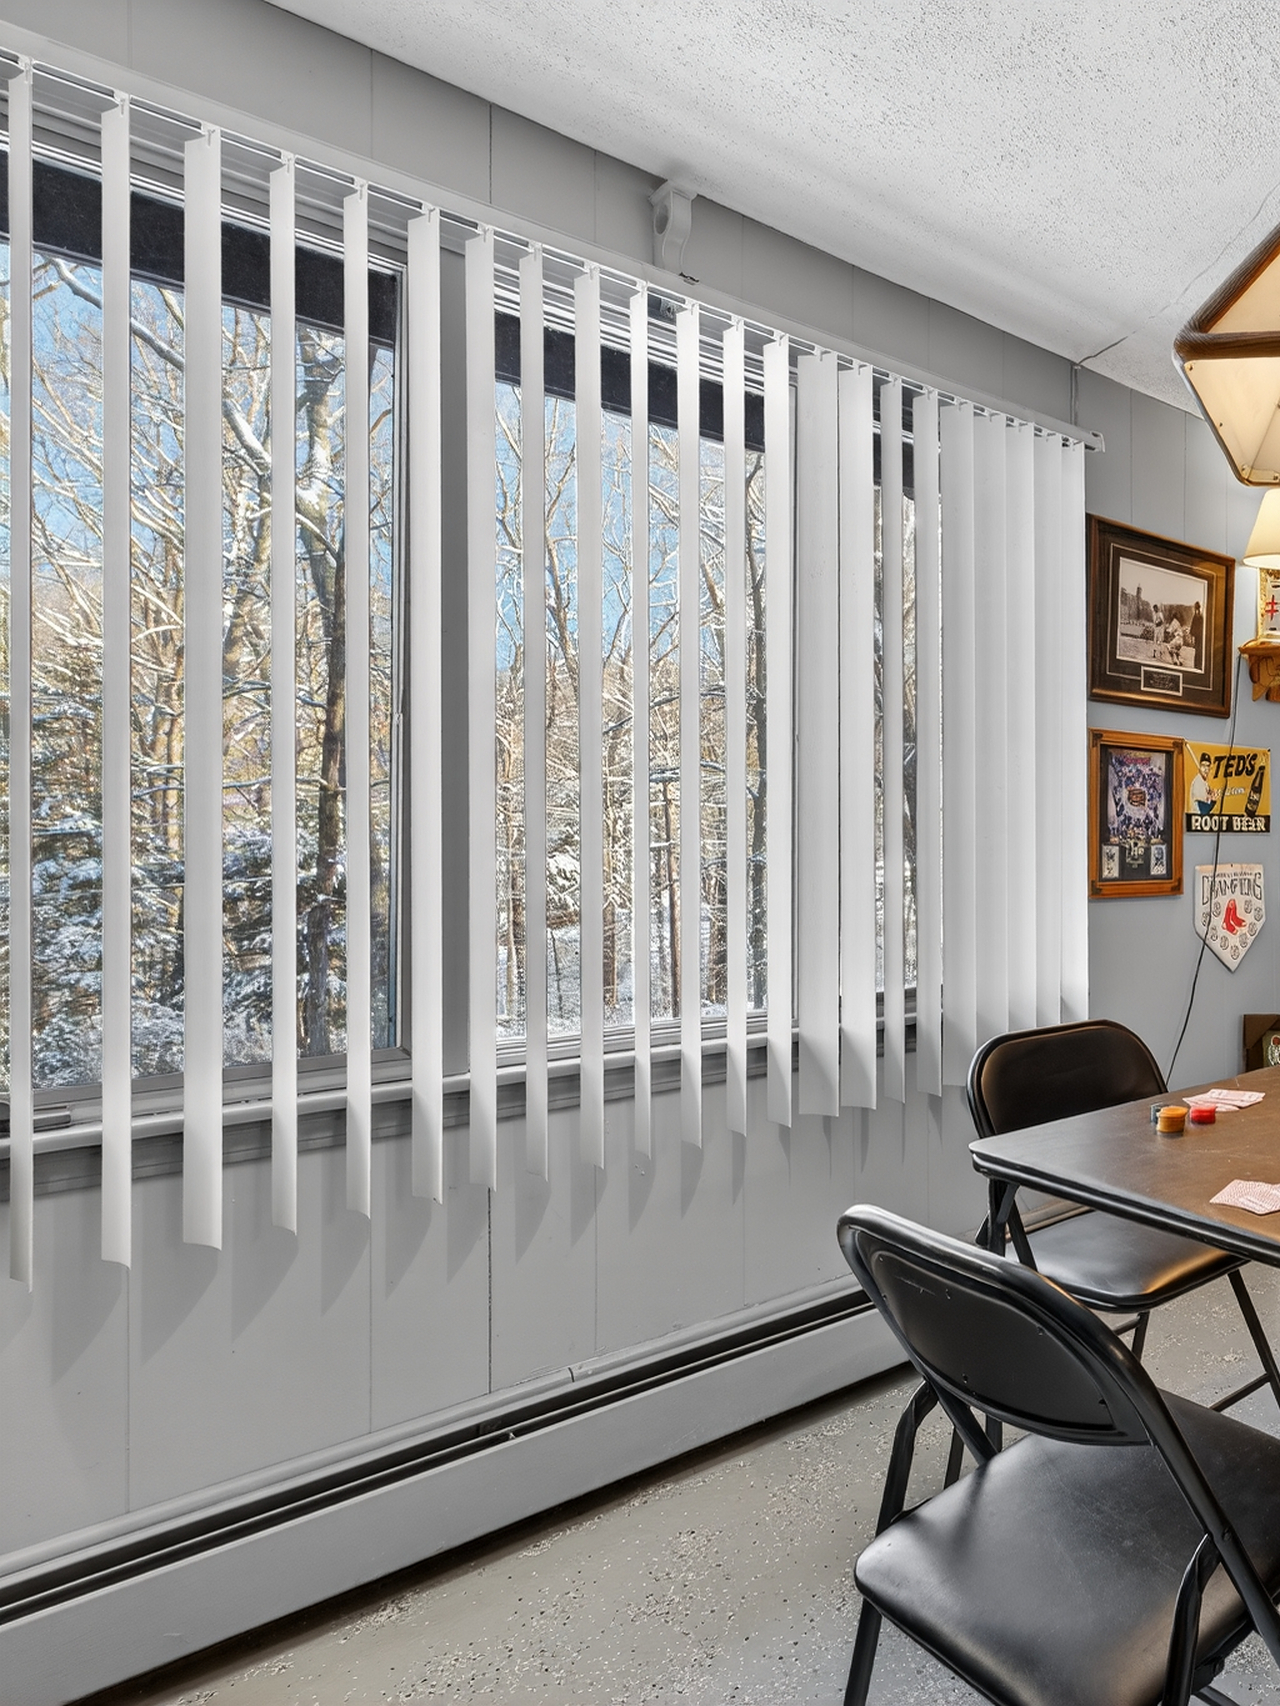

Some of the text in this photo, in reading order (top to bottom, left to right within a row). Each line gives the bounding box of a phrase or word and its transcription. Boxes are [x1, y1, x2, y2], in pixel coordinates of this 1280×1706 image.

[1213, 753, 1258, 779] TED'S
[1191, 815, 1266, 832] ROOT BEER
